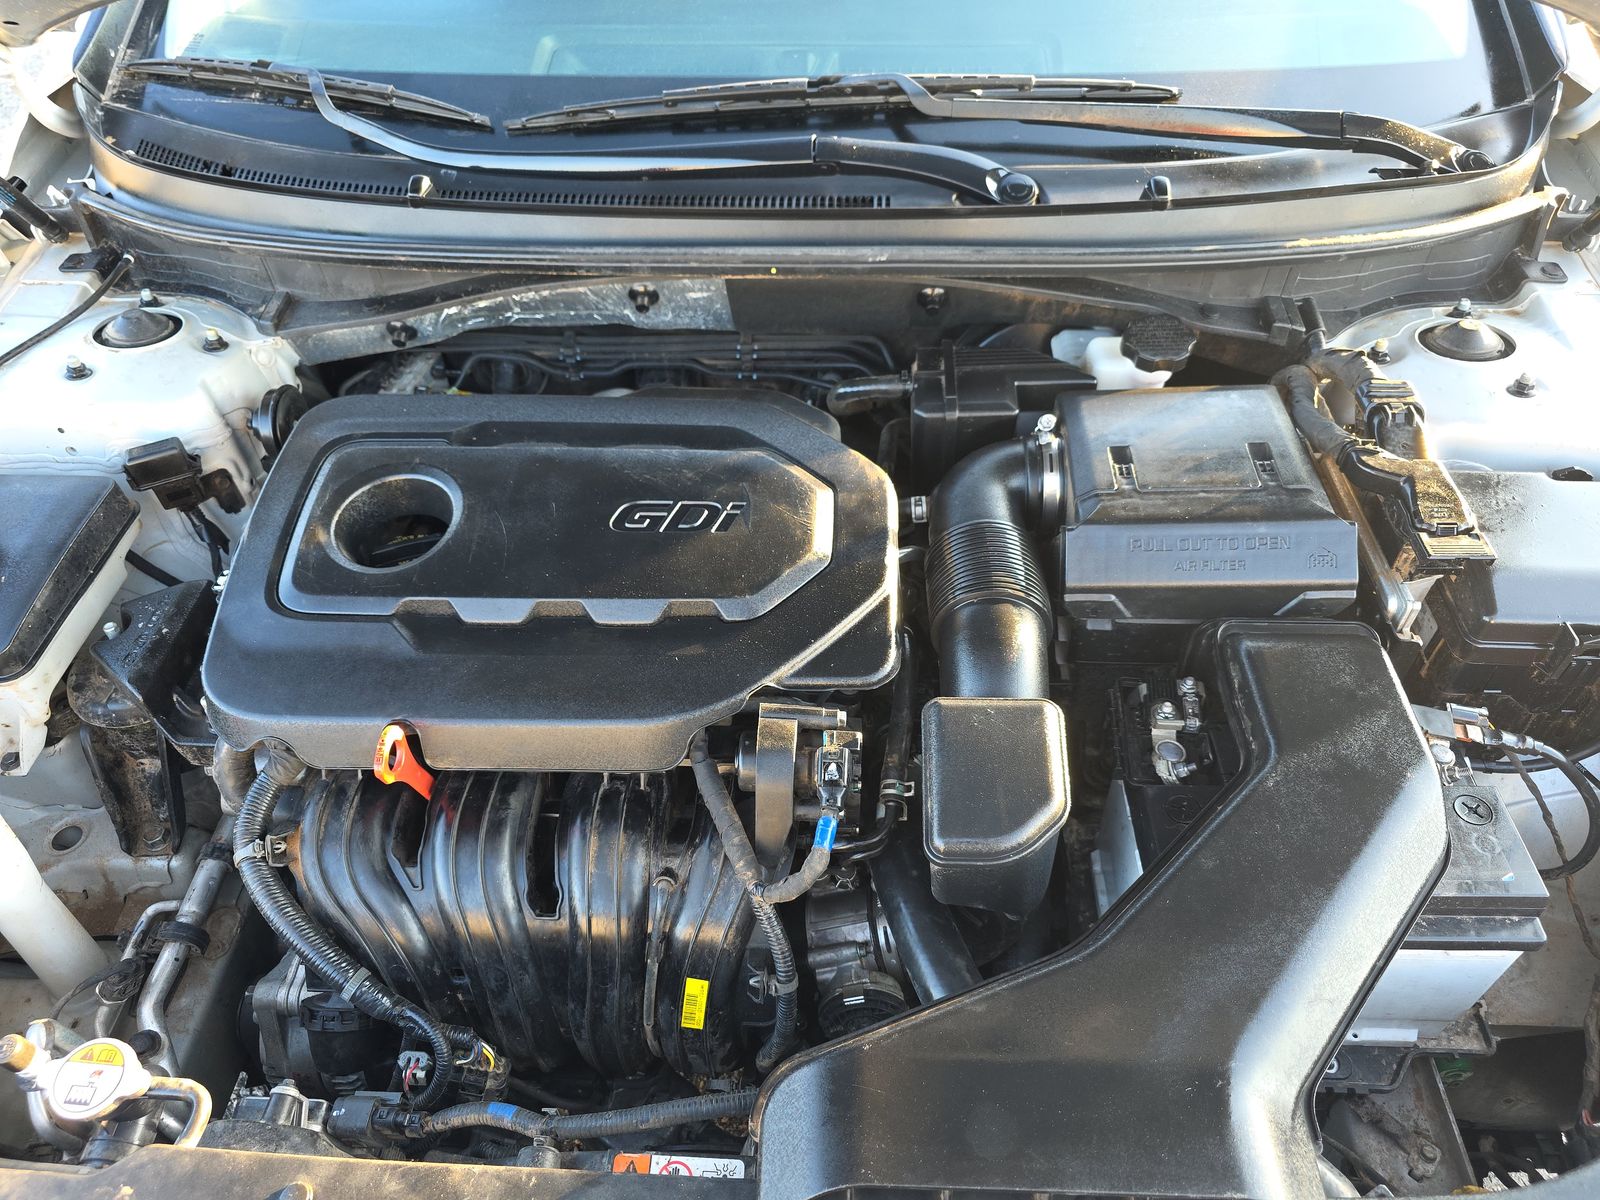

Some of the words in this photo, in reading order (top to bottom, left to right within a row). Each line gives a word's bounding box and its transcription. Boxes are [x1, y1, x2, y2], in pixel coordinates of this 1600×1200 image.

[608, 499, 748, 534] GDi
[1129, 536, 1173, 552] PULL
[1176, 536, 1213, 552] OUT
[1215, 536, 1240, 551] TO
[1243, 535, 1291, 551] OPEN
[1174, 559, 1198, 572] AIR
[1200, 559, 1247, 572] FILTER
